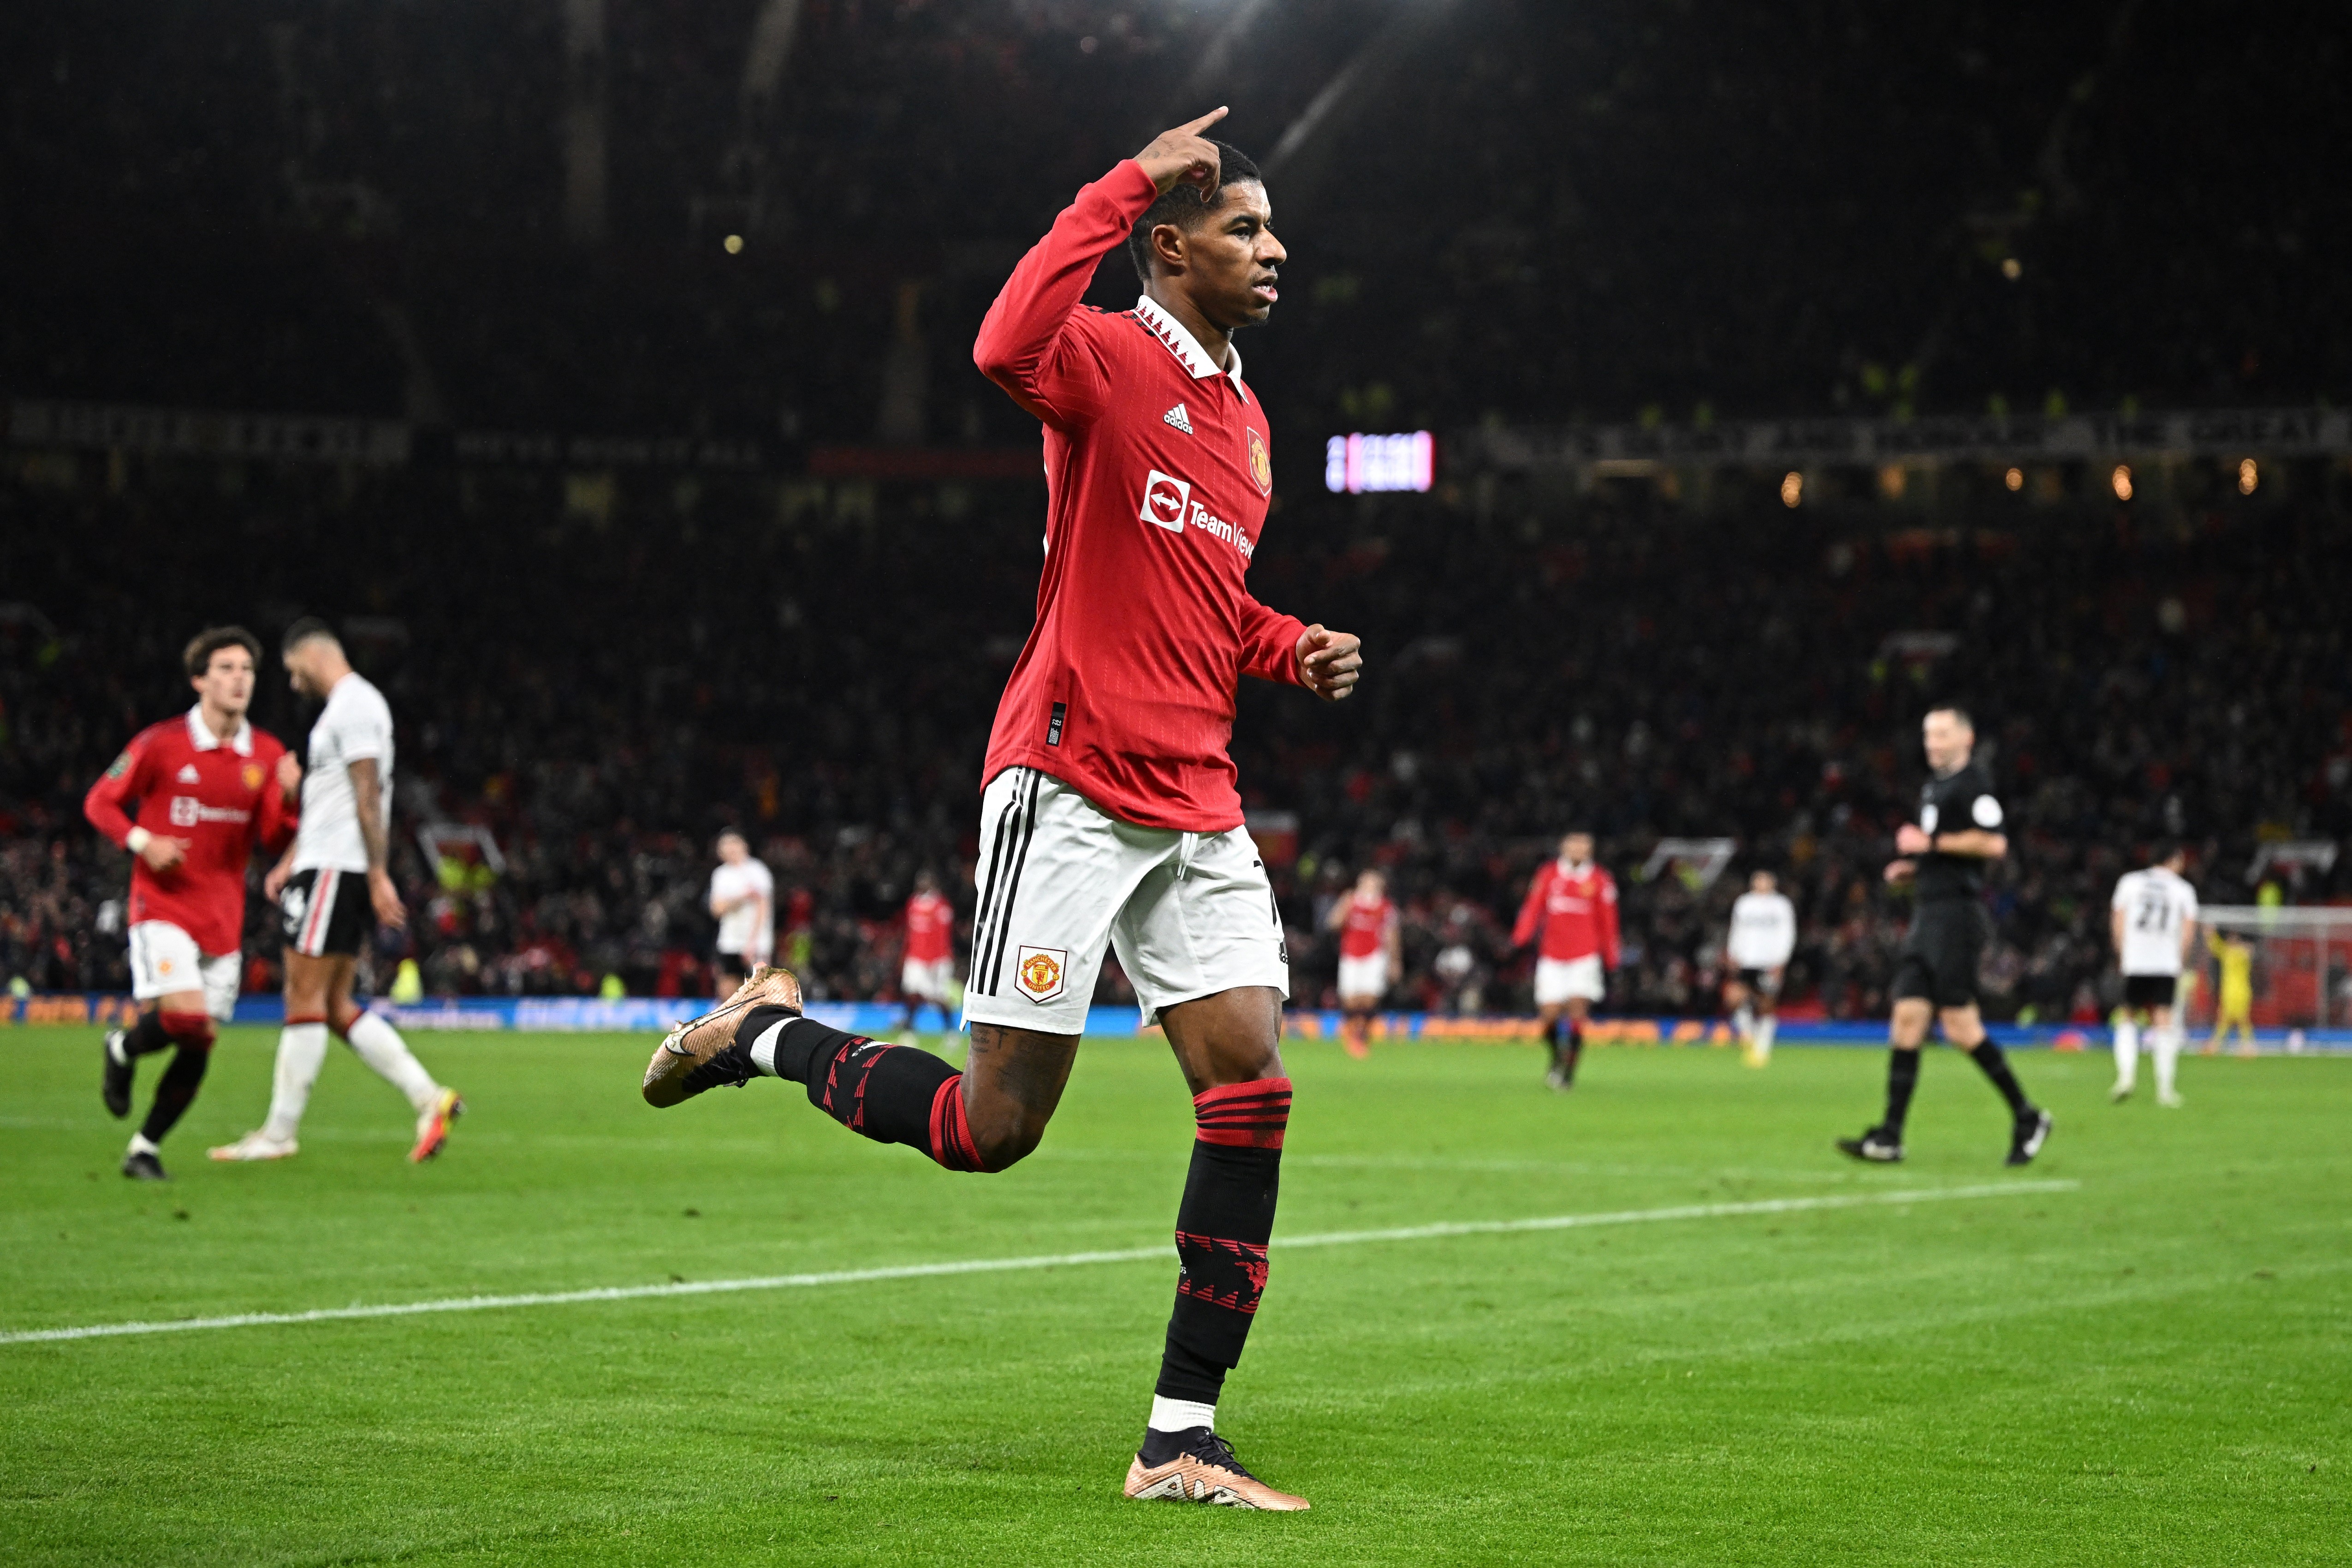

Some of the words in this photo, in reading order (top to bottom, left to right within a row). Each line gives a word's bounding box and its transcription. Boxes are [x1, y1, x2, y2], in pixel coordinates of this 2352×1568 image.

[1164, 414, 1193, 434] adidas
[1190, 499, 1254, 559] TeamView
[1026, 956, 1057, 971] MANCHESTER
[1028, 982, 1050, 991] UNITED
